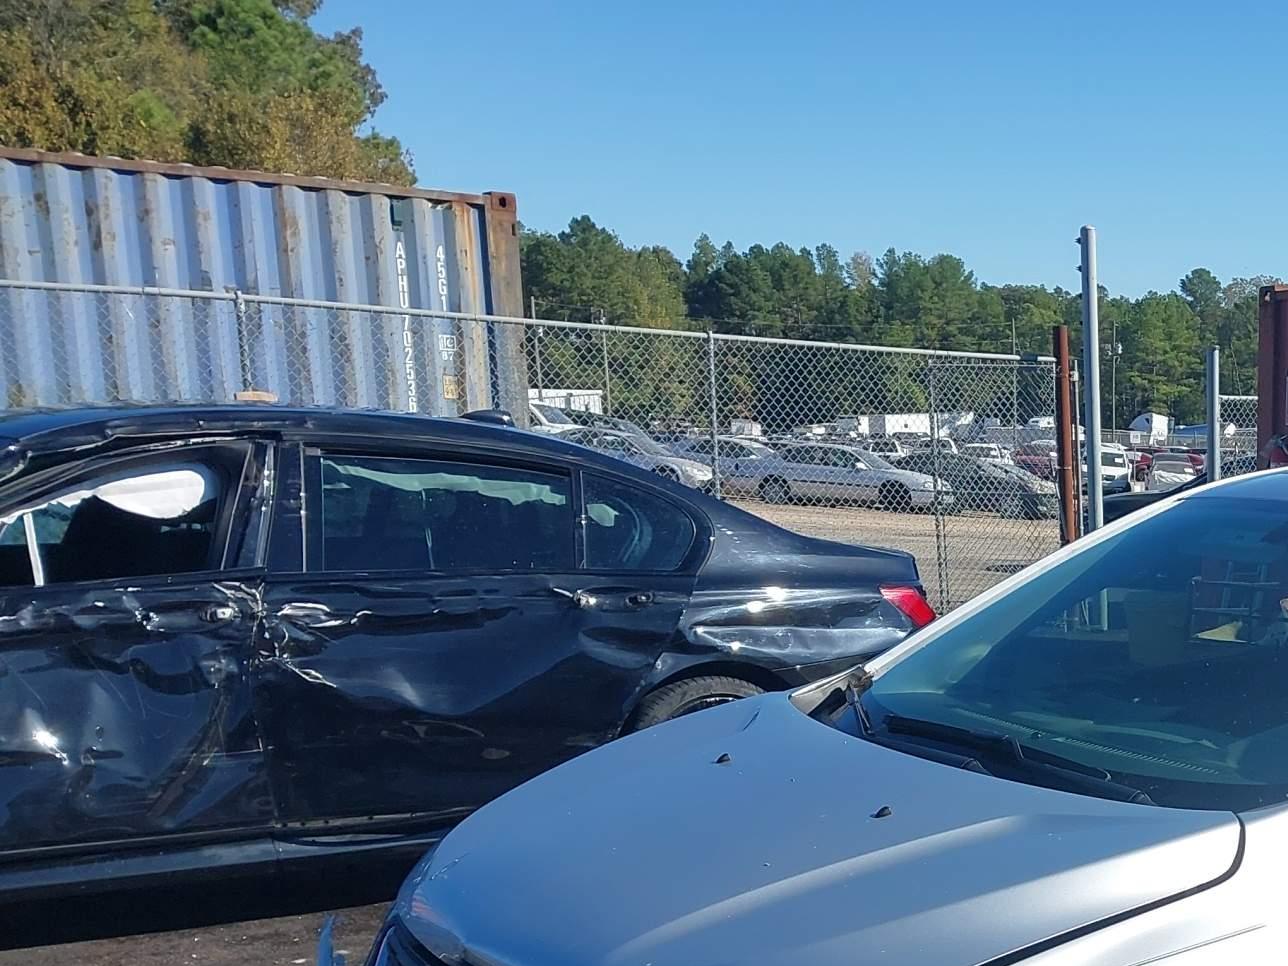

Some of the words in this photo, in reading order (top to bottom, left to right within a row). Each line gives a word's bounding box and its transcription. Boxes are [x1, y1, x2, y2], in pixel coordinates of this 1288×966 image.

[395, 241, 409, 309] APHU
[402, 315, 417, 413] 702536
[436, 245, 447, 312] 45G1
